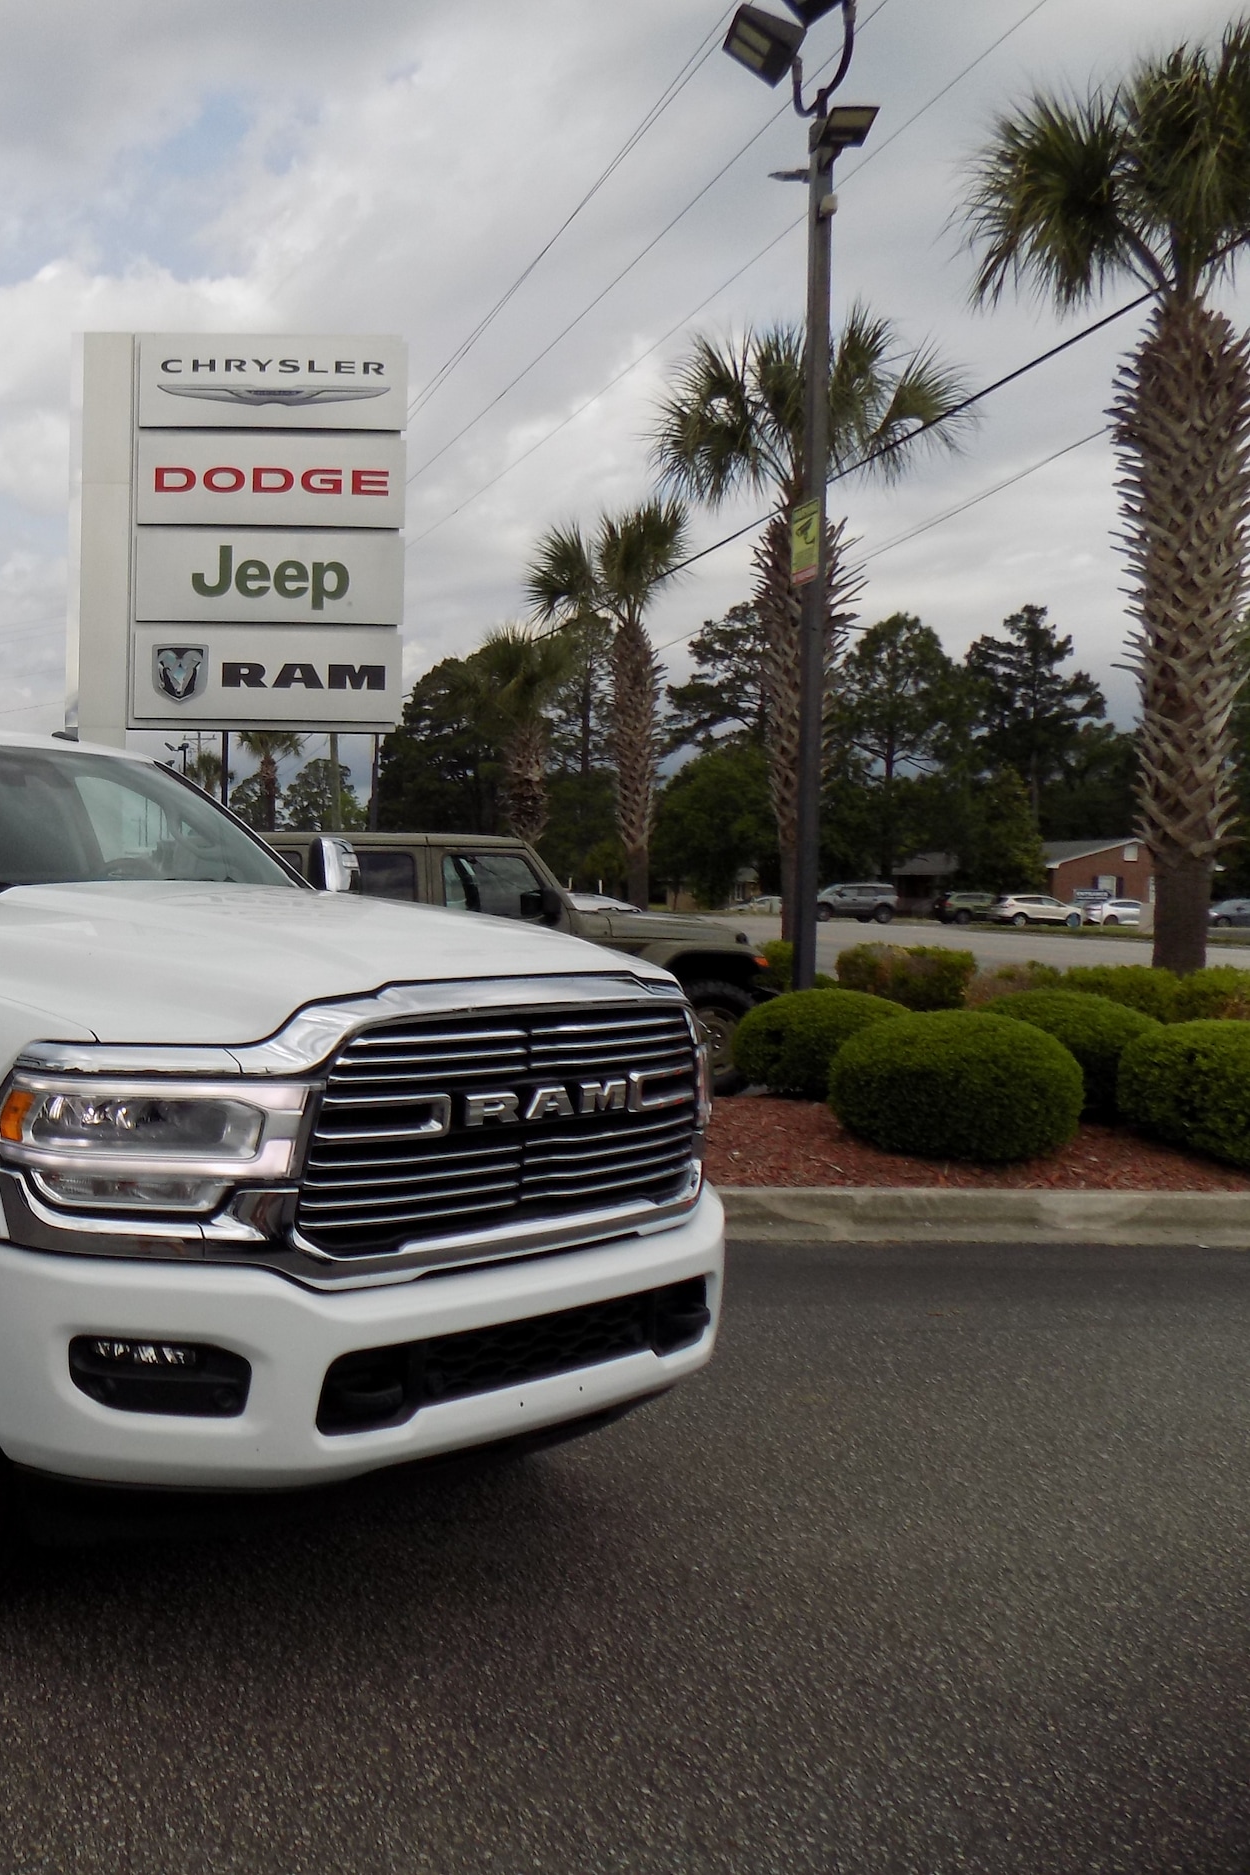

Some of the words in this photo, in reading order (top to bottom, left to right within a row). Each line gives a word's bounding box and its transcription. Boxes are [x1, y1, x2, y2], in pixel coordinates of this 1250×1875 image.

[161, 358, 385, 376] CHRYSLER
[154, 466, 390, 496] DODGE
[191, 545, 350, 611] Jeep
[221, 662, 387, 691] RAM
[465, 1079, 627, 1127] RAM
